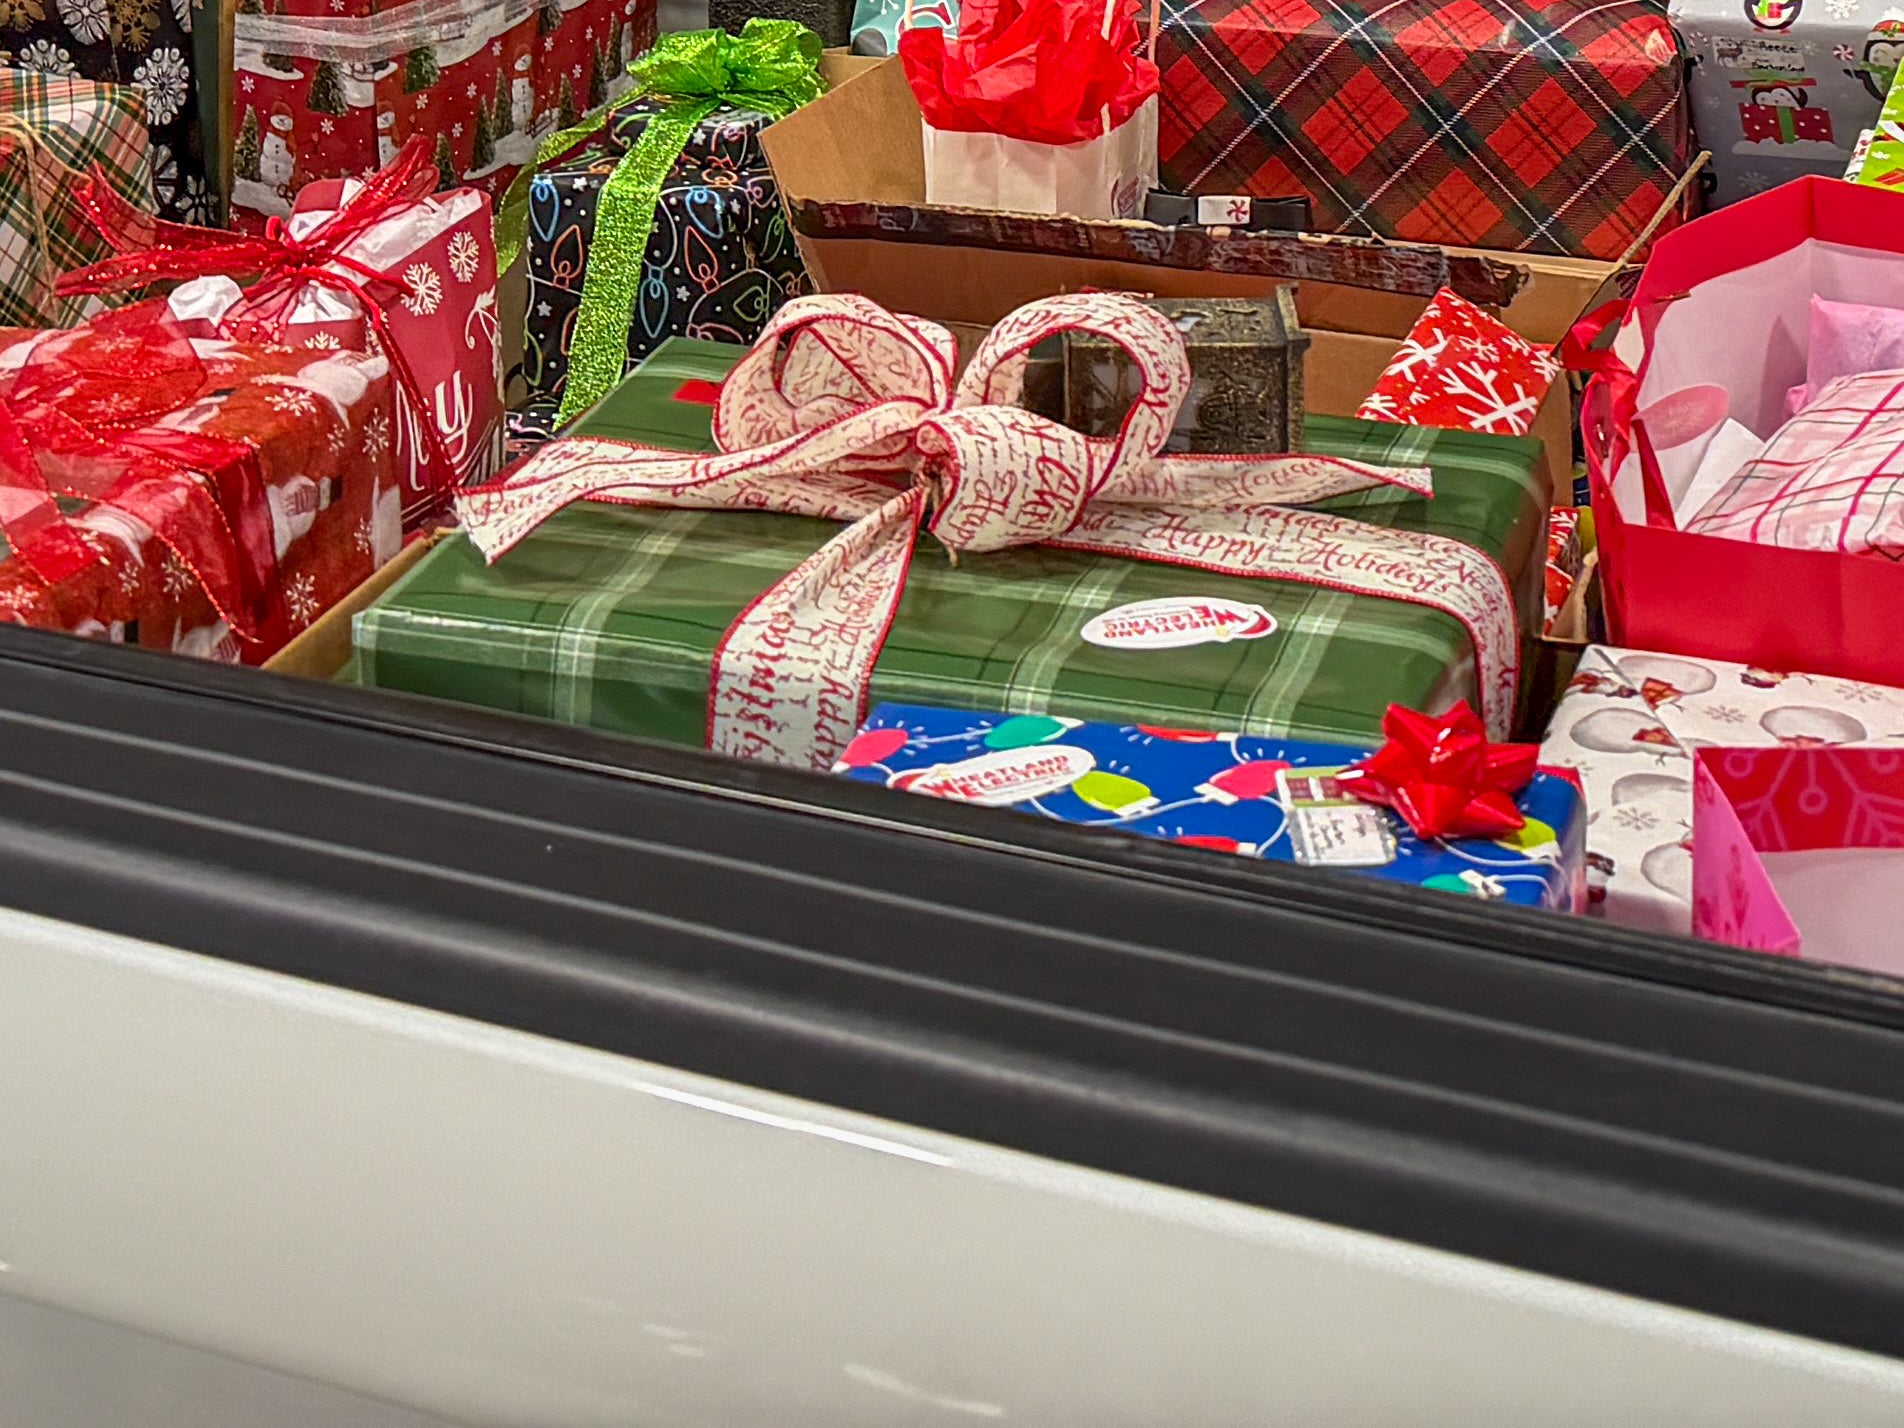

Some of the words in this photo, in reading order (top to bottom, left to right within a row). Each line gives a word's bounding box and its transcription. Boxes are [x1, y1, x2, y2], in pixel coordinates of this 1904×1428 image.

[1142, 506, 1267, 564] Happy
[1298, 537, 1454, 594] Holidays
[1105, 606, 1245, 638] WHEATLAND
[920, 754, 1069, 798] WHEATLAND
